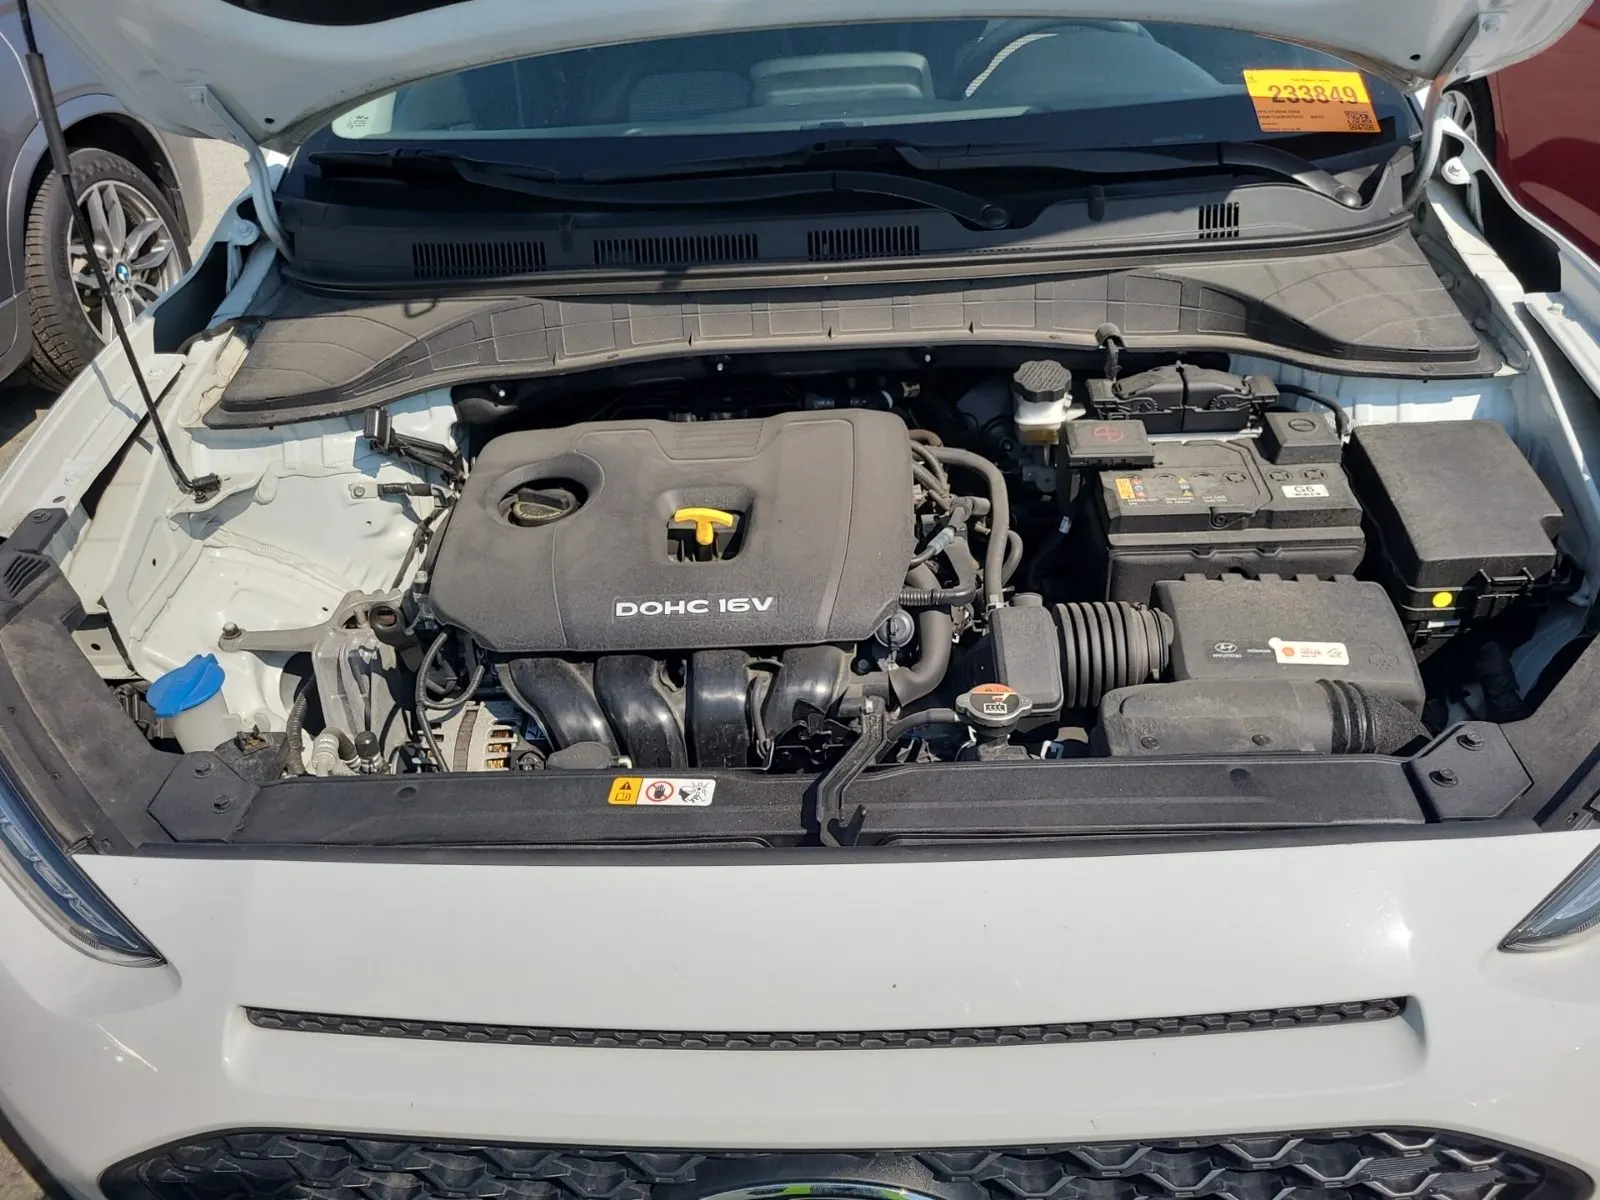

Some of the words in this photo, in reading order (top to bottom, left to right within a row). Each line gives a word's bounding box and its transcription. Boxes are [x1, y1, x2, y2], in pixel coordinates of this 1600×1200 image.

[1268, 84, 1358, 104] 233849
[615, 600, 709, 617] DOHC
[719, 597, 774, 613] 16V
